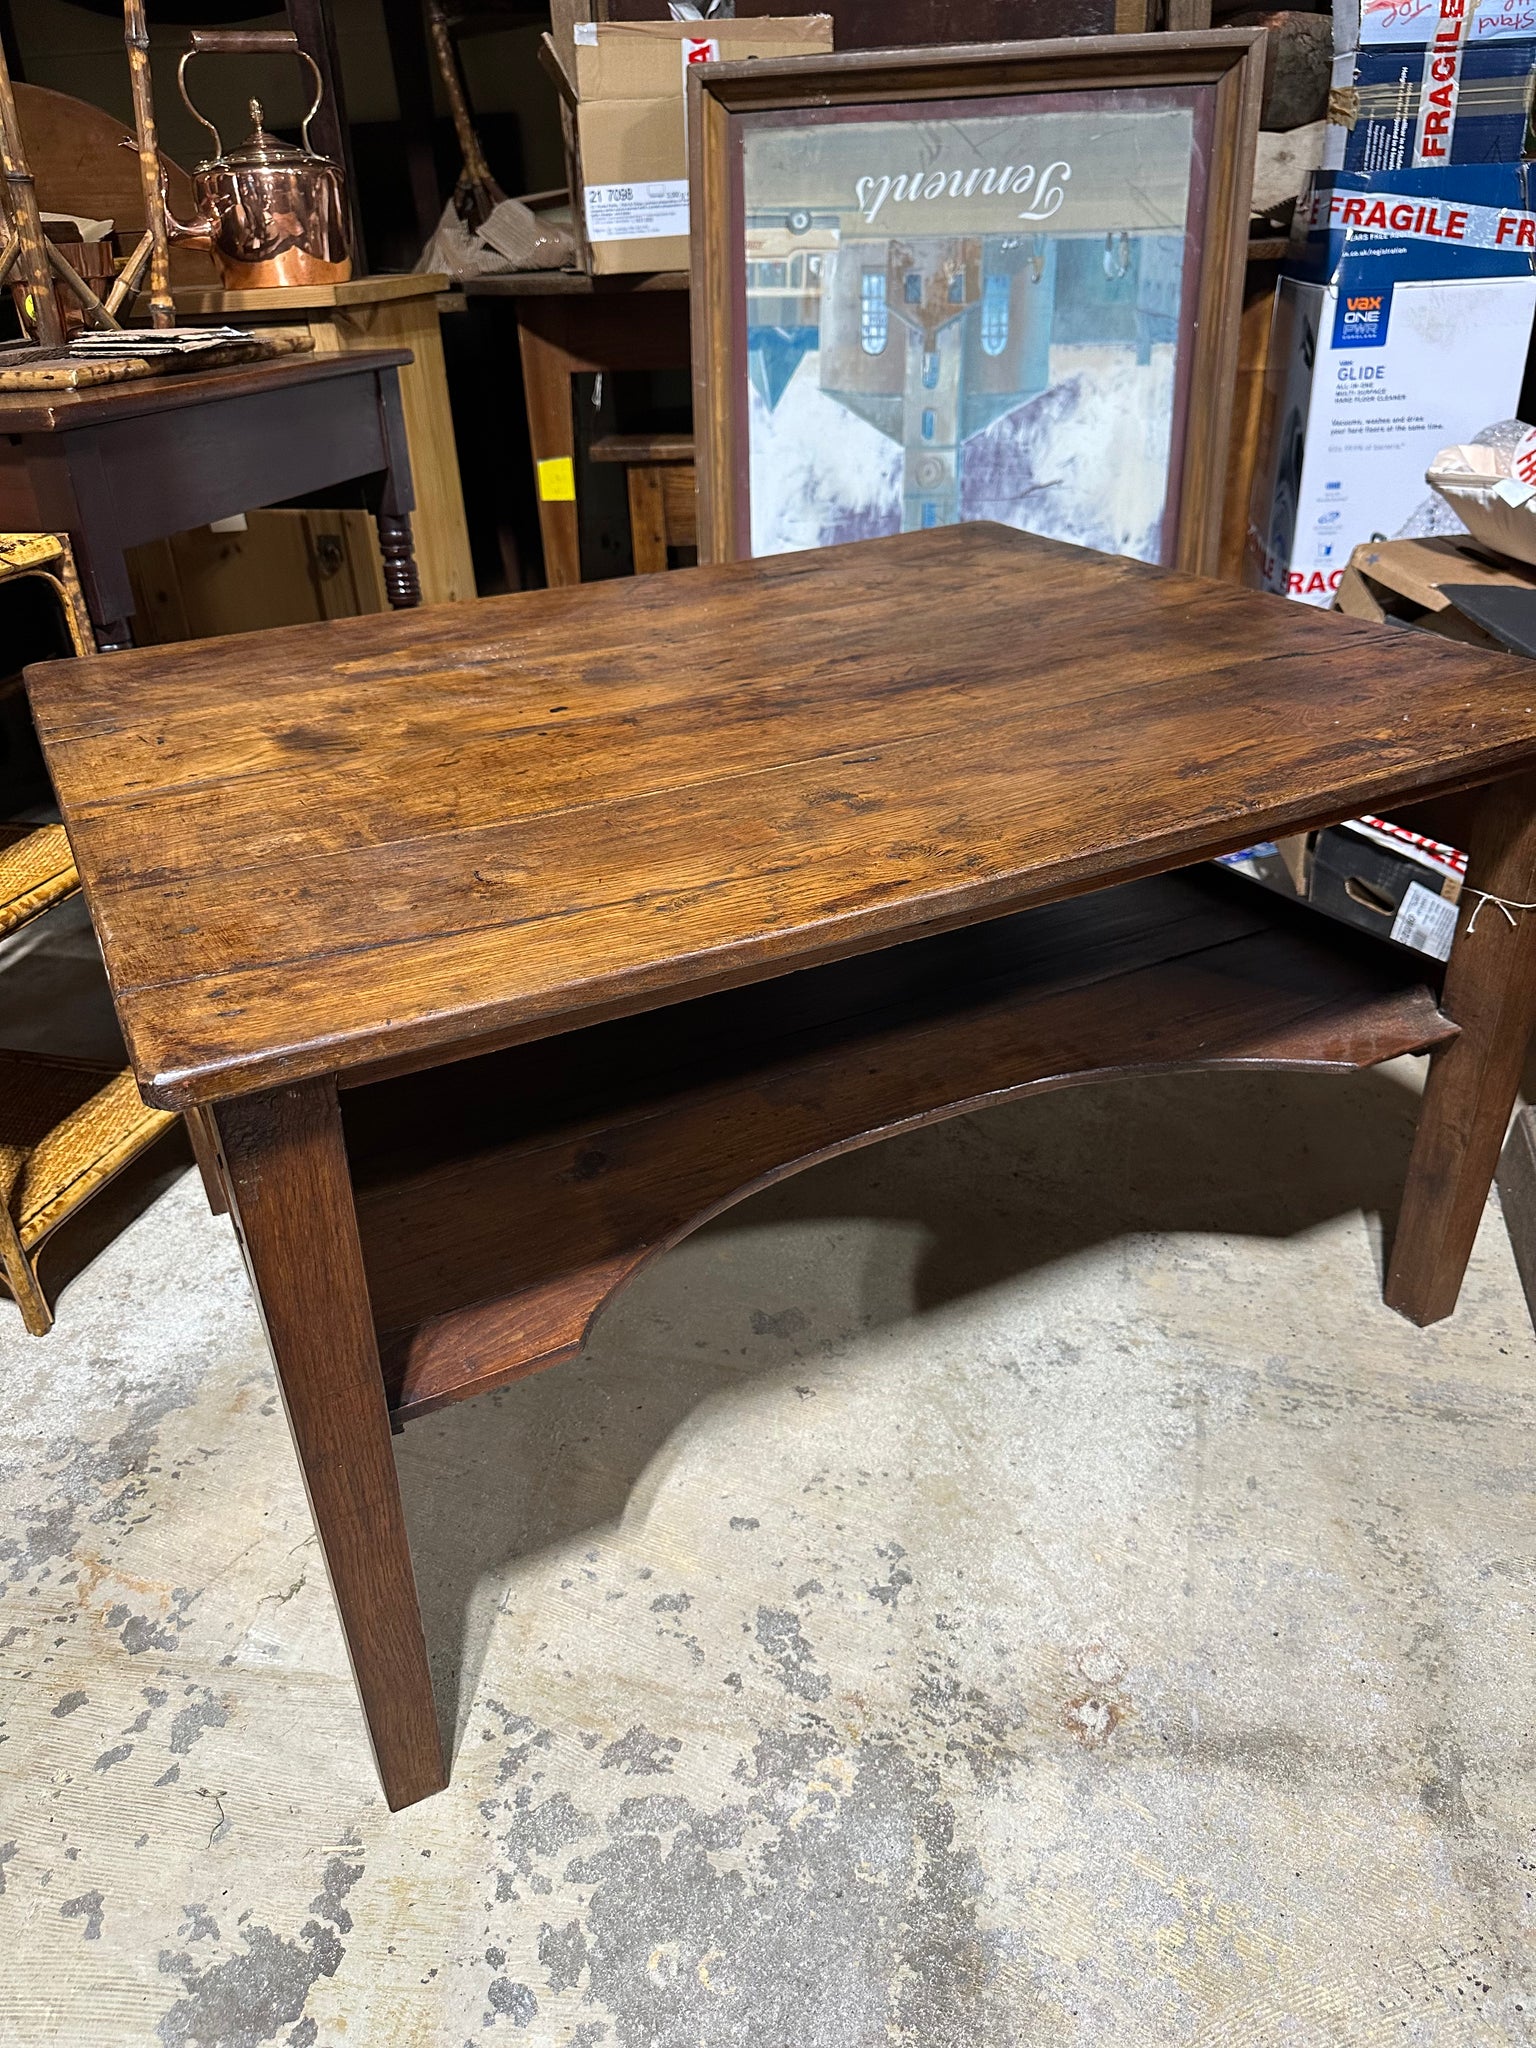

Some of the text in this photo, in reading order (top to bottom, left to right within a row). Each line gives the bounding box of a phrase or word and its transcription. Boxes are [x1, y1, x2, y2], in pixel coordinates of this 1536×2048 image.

[1421, 0, 1465, 157] FRAGILE
[589, 187, 634, 204] 21 7098
[1330, 196, 1469, 240] FRAGILE
[1346, 296, 1383, 311] vax
[1344, 310, 1380, 324] ONE
[1342, 323, 1378, 335] PWR
[1337, 365, 1386, 381] GLIDE
